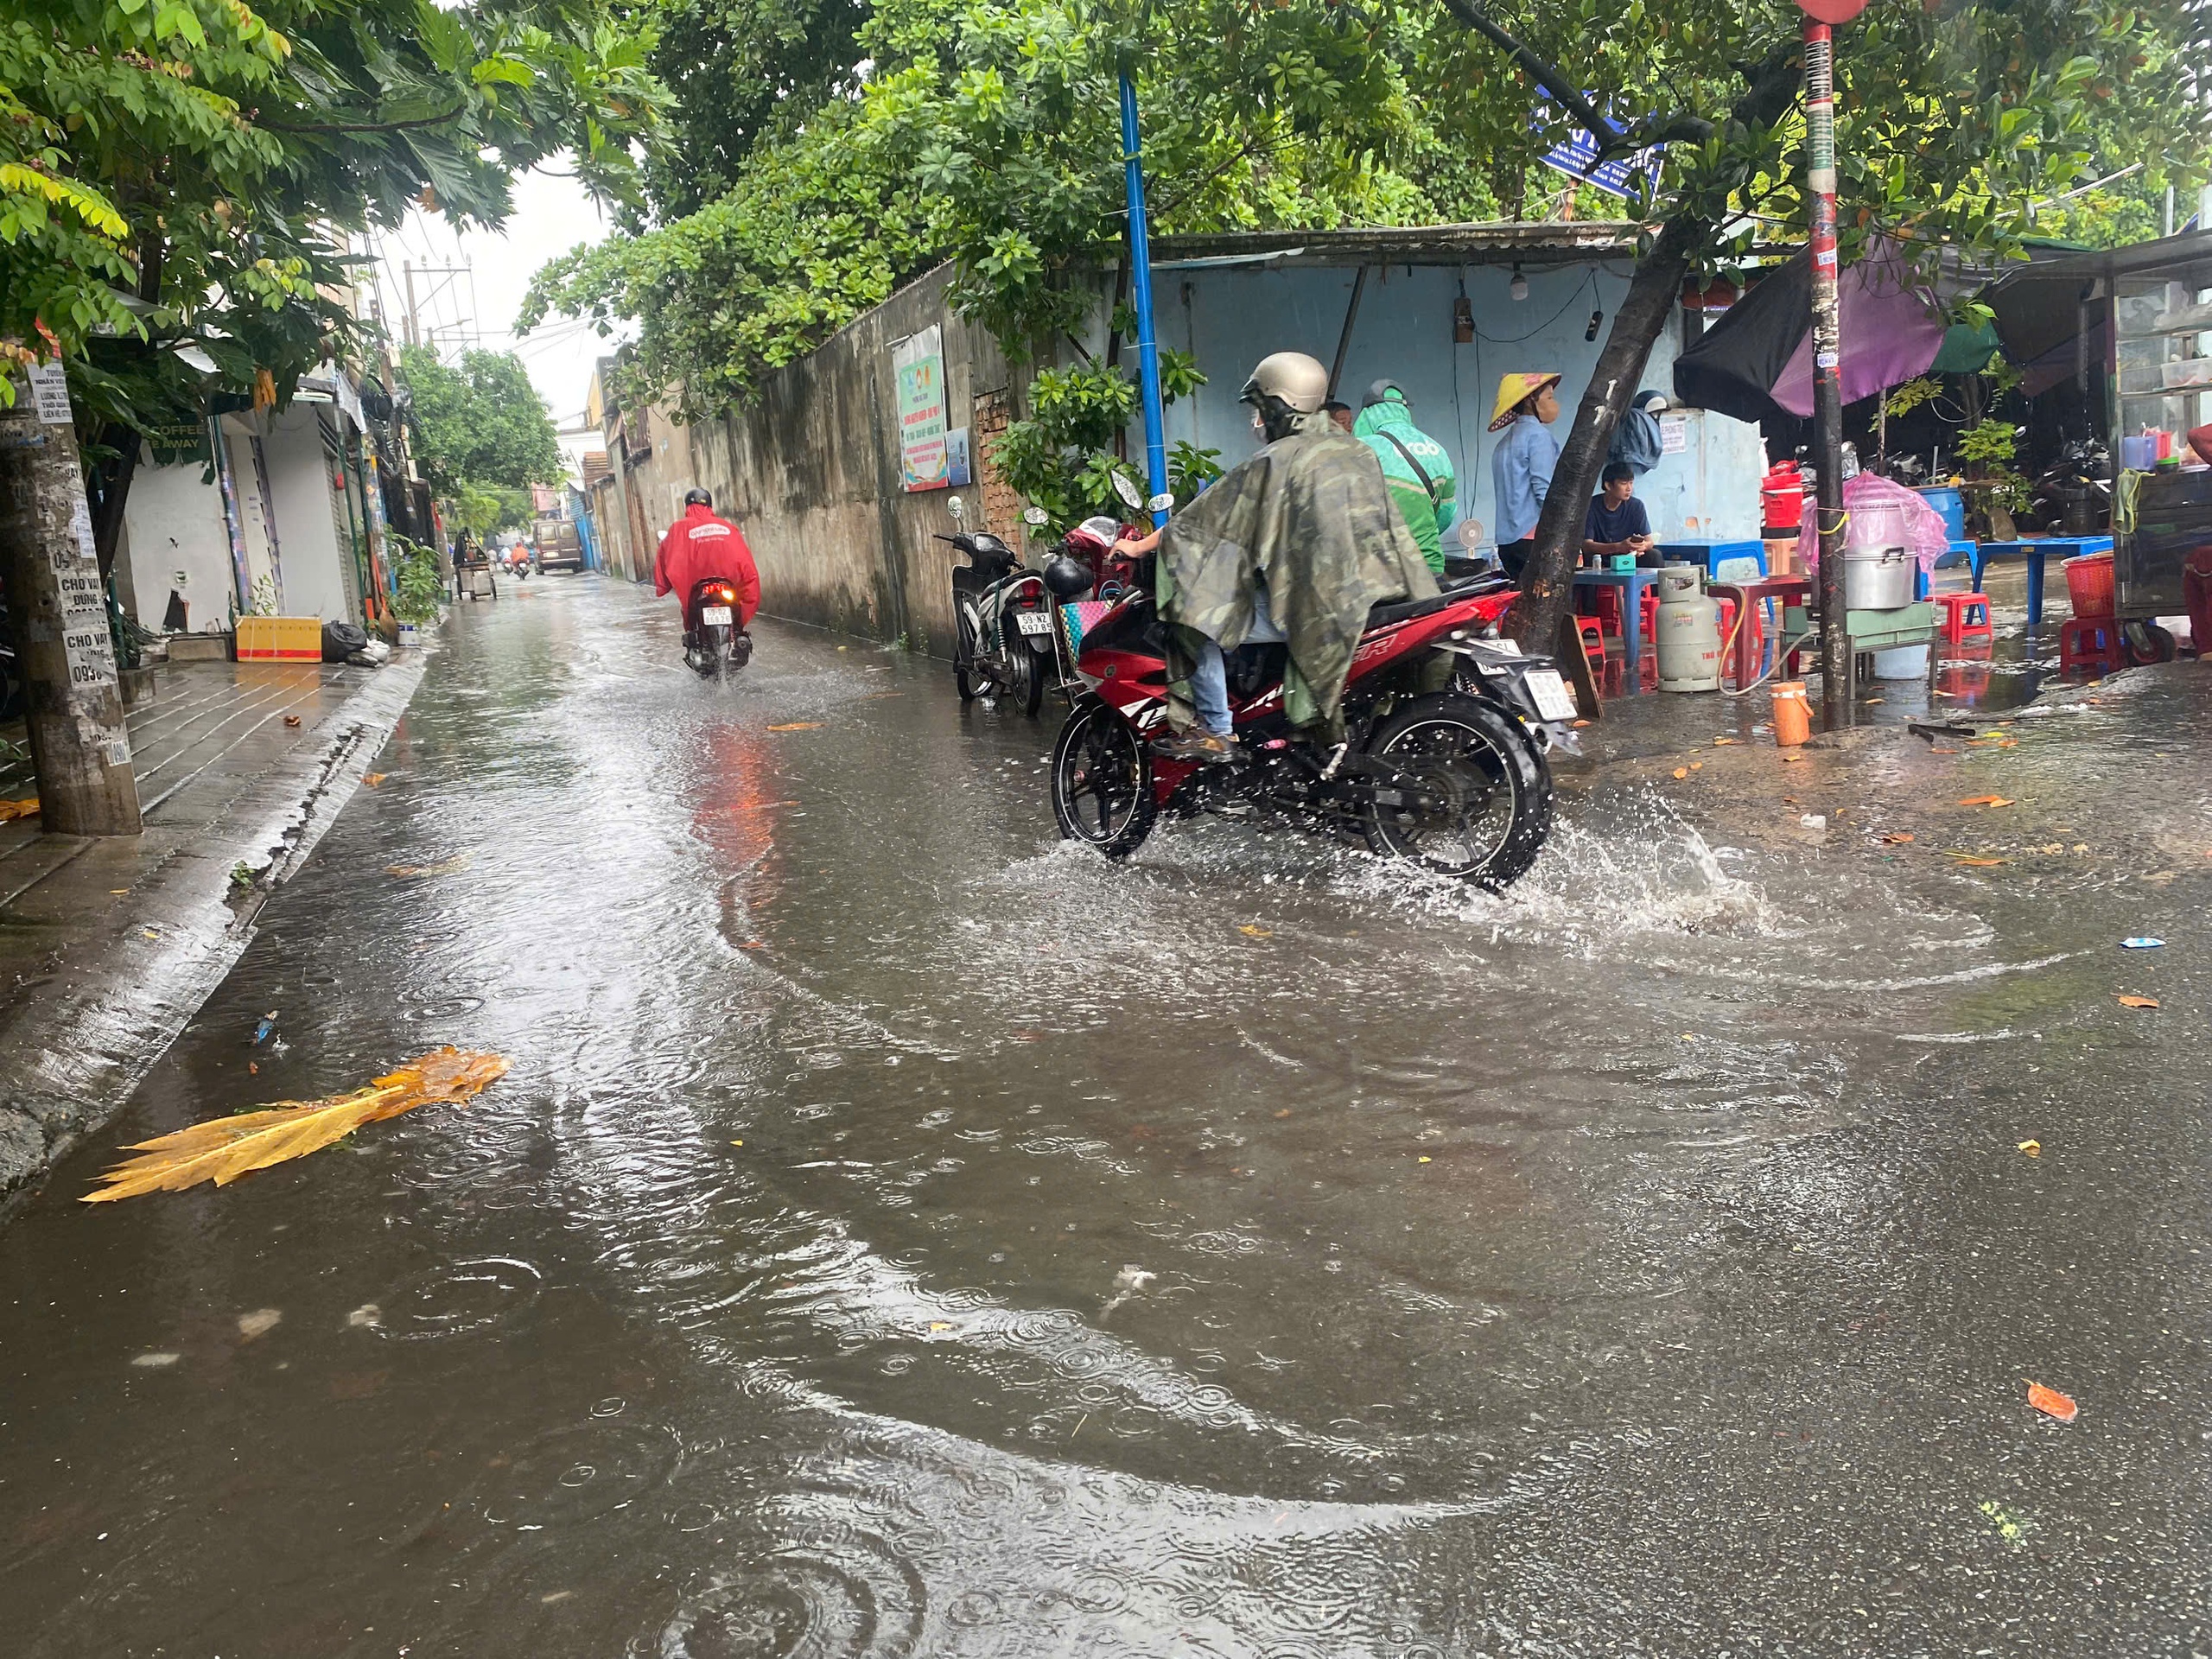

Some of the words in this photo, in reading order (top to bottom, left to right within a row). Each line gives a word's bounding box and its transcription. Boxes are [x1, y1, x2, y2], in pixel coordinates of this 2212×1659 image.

[1393, 440, 1440, 458] rab
[61, 578, 86, 591] CHO
[67, 634, 92, 648] CHO
